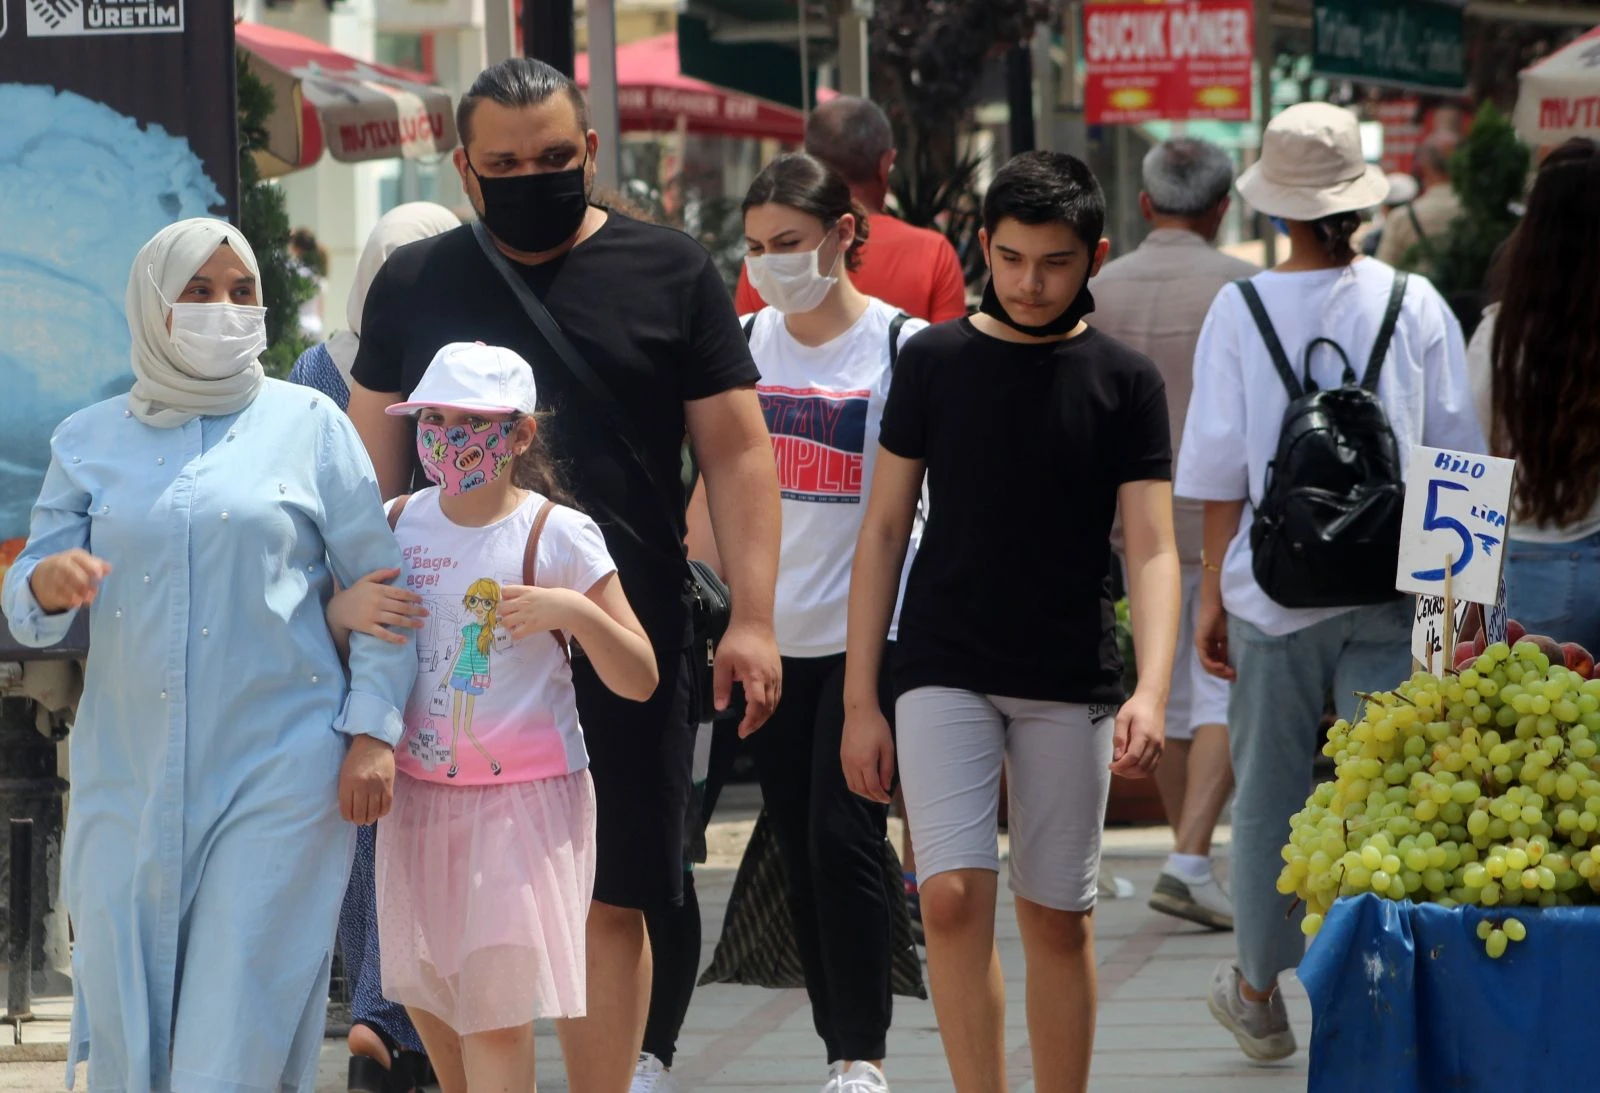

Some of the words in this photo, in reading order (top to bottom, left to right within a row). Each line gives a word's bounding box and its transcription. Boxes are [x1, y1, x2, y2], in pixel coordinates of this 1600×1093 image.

[88, 4, 176, 27] ÜRETİM
[1087, 12, 1166, 60] SUCUK
[1170, 1, 1250, 57] DÖNER
[1411, 479, 1474, 581] 5
